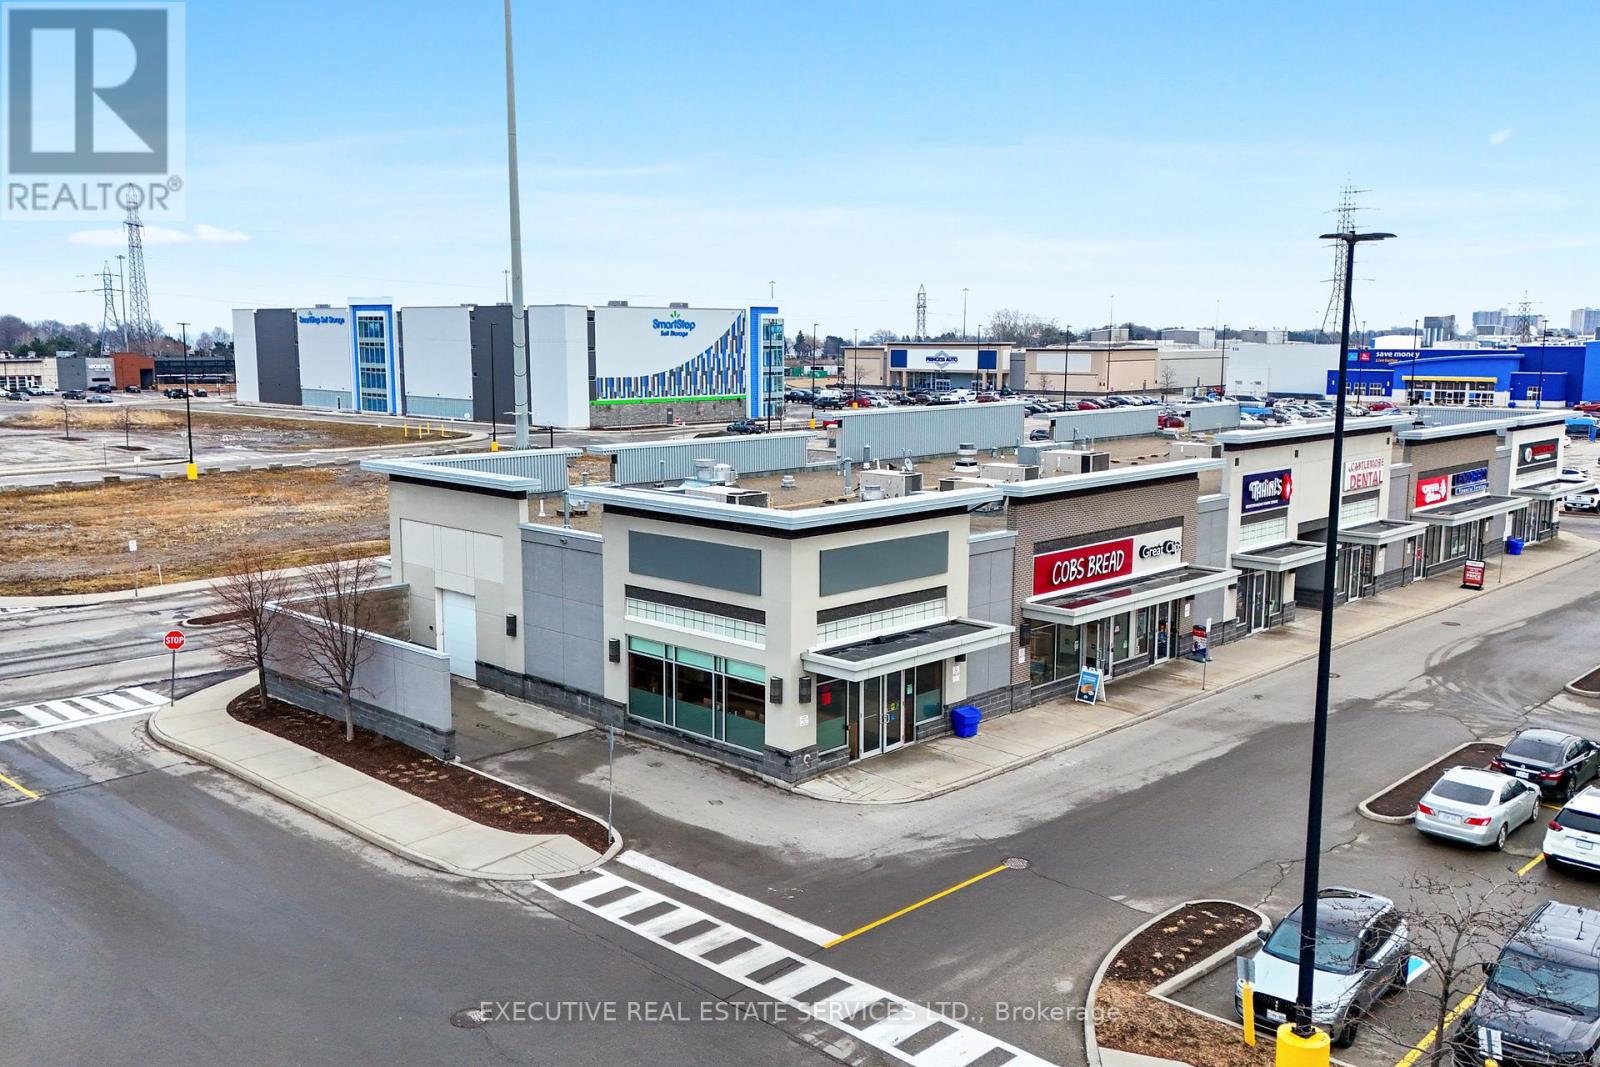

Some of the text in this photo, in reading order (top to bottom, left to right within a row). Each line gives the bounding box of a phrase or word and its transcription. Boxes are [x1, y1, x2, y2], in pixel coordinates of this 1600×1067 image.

[653, 318, 696, 331] SmartStop
[1393, 351, 1420, 359] money
[1350, 470, 1384, 489] DENTAL
[1139, 539, 1183, 559] Great Clips
[1052, 550, 1125, 585] COBS BREAD
[165, 636, 184, 644] STOP
